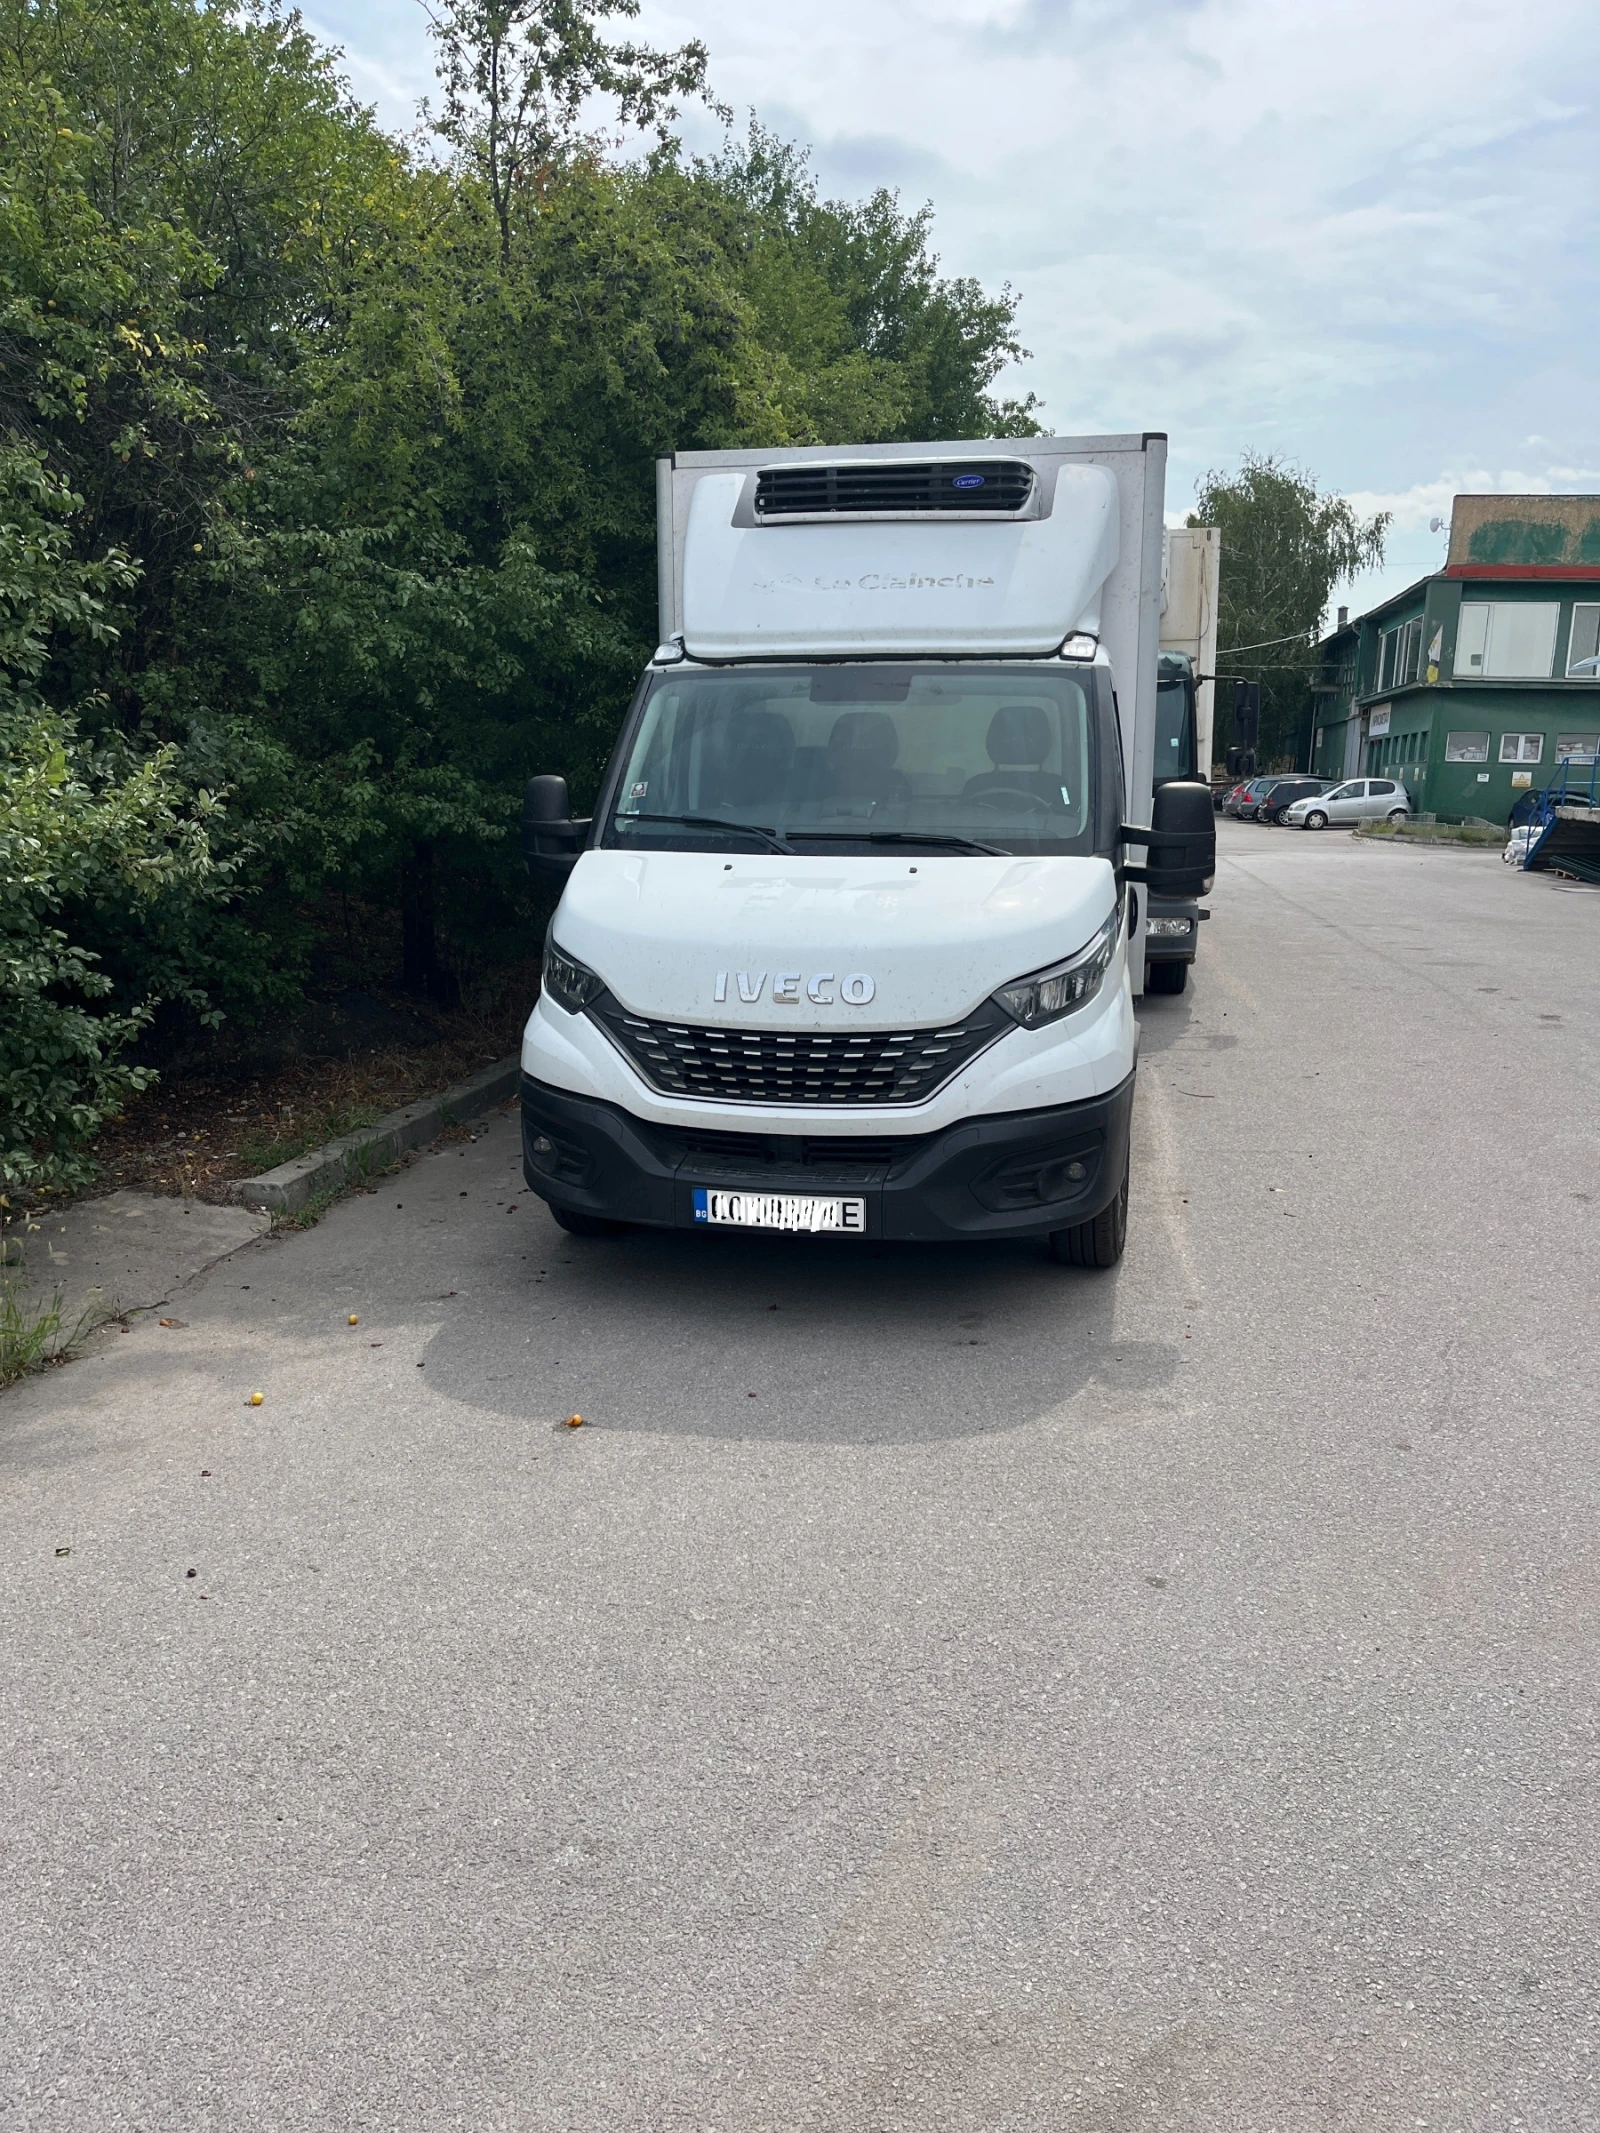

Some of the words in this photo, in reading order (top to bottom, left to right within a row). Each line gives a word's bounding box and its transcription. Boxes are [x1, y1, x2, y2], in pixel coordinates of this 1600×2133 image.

[956, 478, 981, 486] Carrier
[714, 972, 876, 1005] IVECO
[695, 1209, 707, 1219] BG
